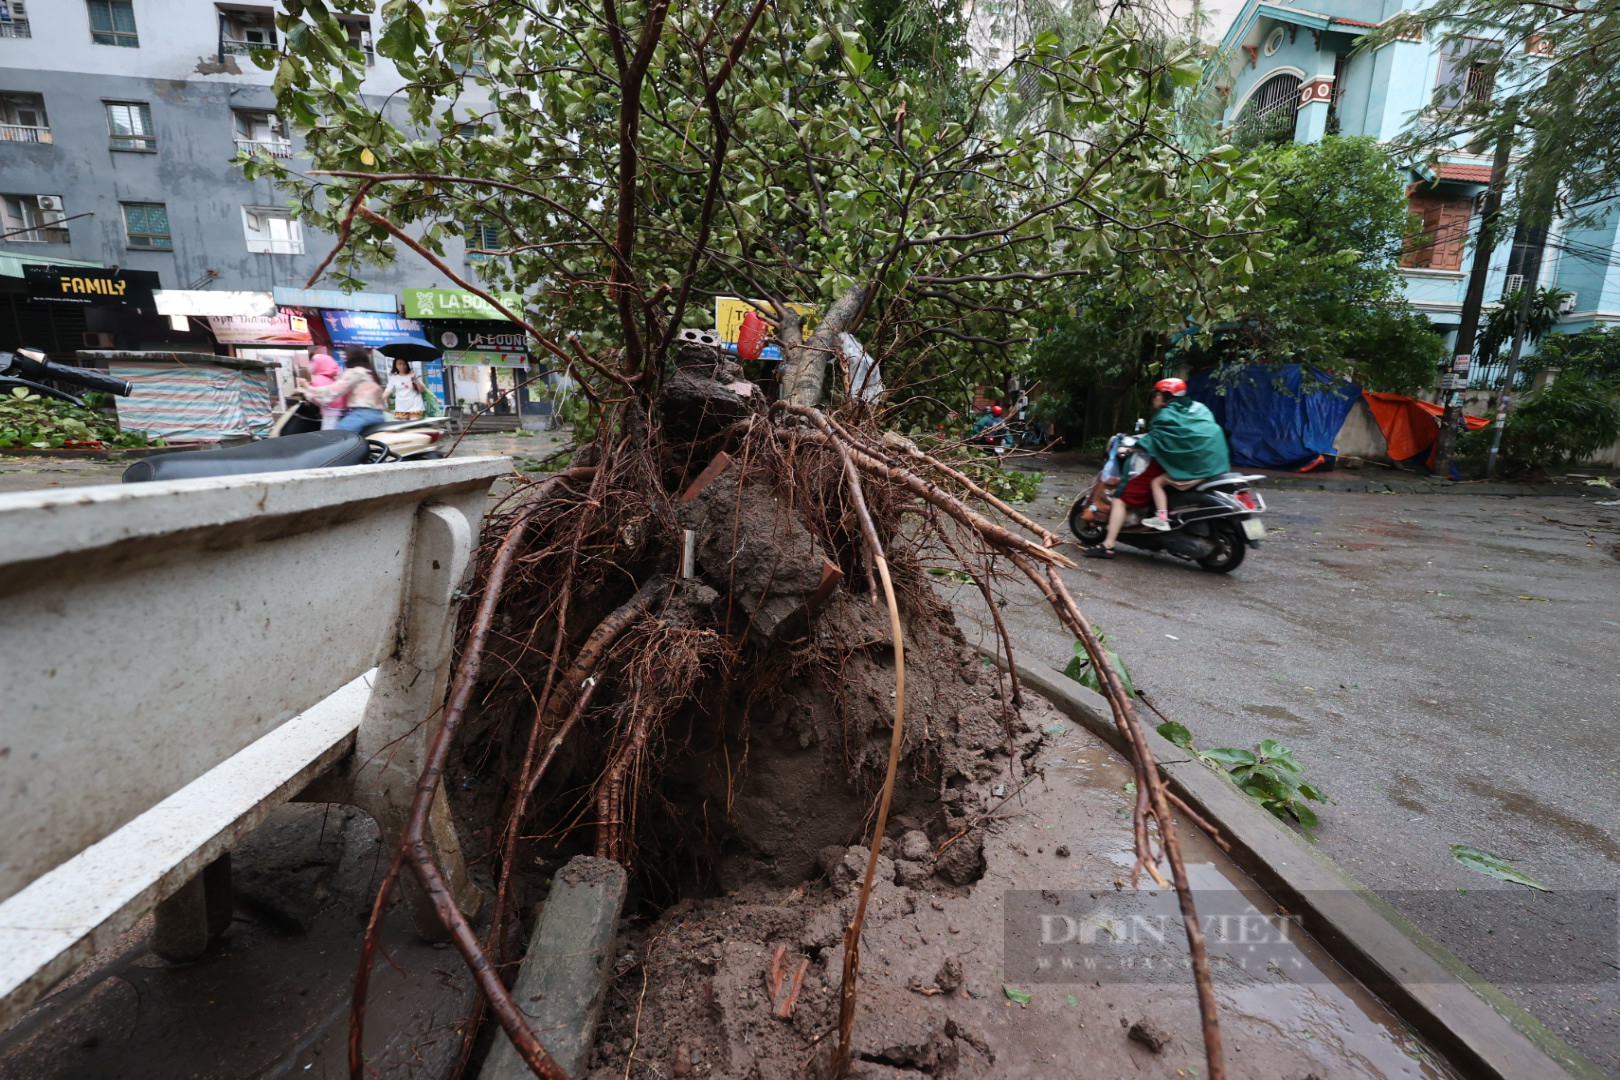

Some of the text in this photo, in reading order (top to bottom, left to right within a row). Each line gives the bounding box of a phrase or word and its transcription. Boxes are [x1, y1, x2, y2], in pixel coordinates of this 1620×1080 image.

[60, 277, 126, 296] FAMILY
[439, 294, 460, 309] LA
[467, 333, 484, 345] LA
